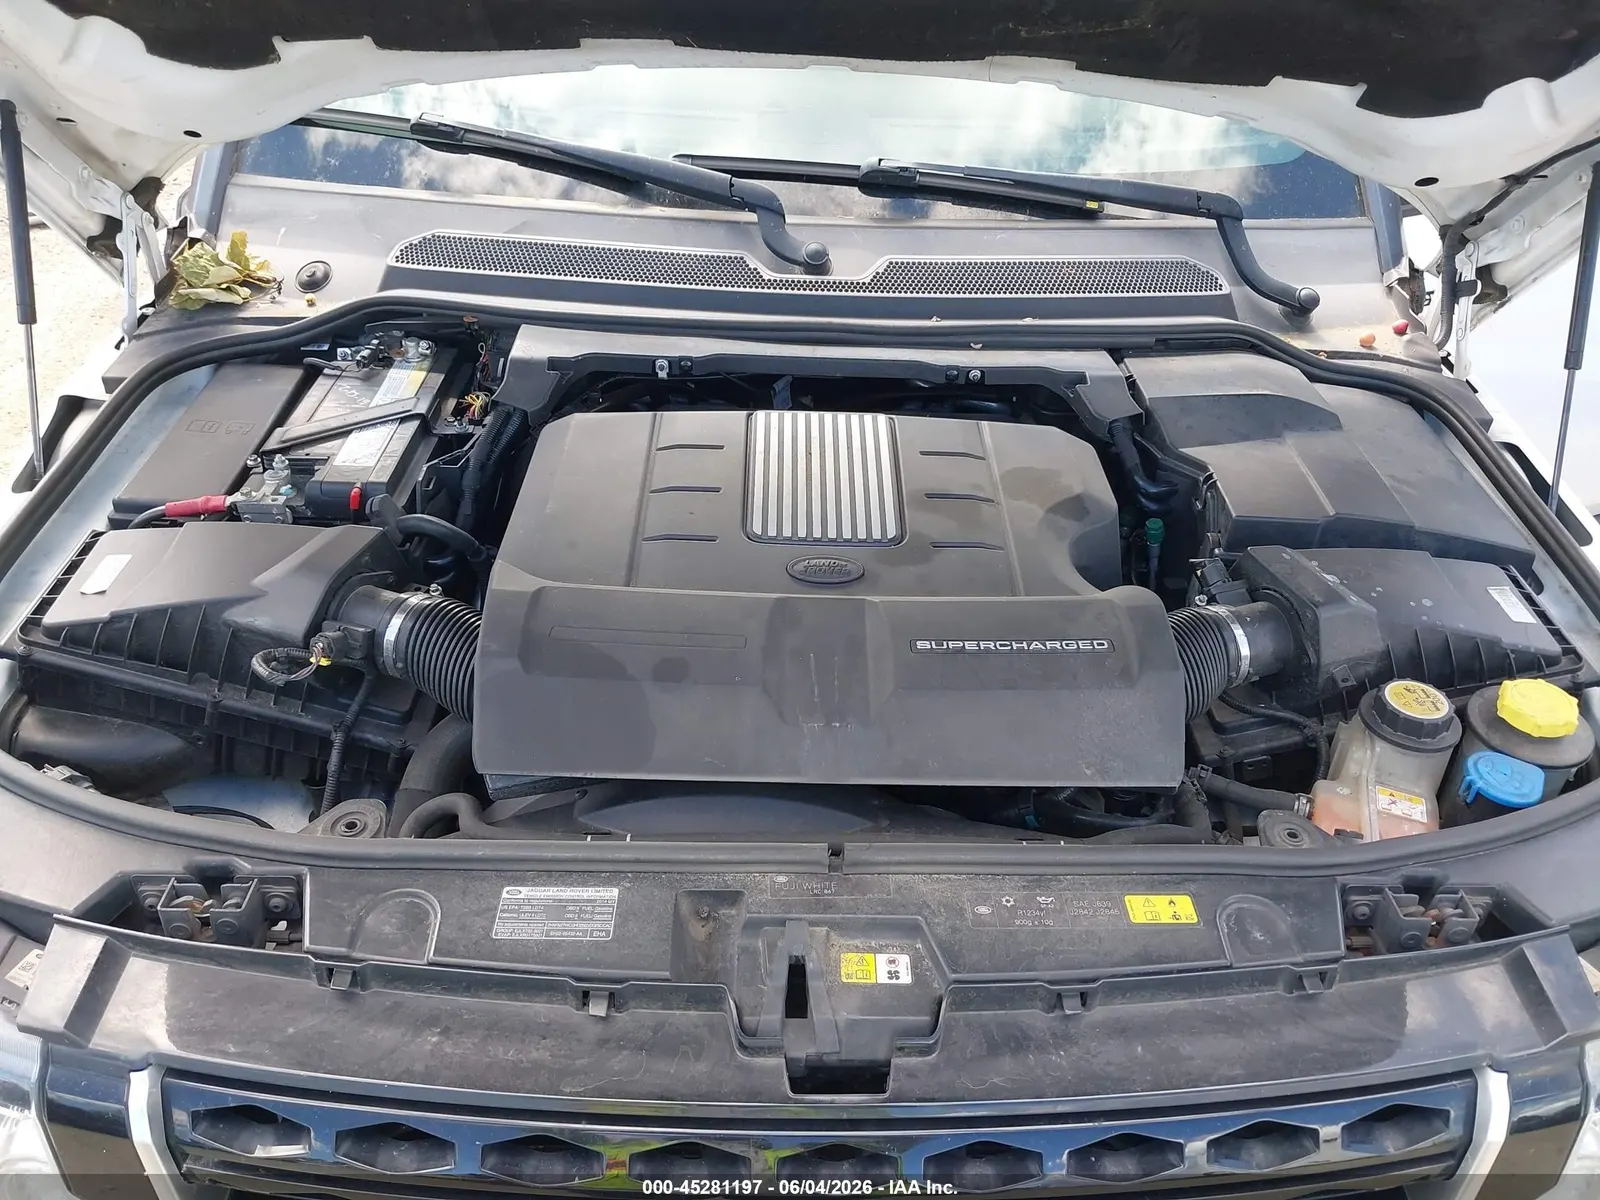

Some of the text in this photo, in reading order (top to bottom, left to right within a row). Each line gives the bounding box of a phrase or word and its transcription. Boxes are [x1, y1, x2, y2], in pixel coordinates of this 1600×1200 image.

[806, 567, 850, 576] ROVER
[916, 640, 1109, 650] SUPERCHARGED
[802, 882, 837, 890] WHITE
